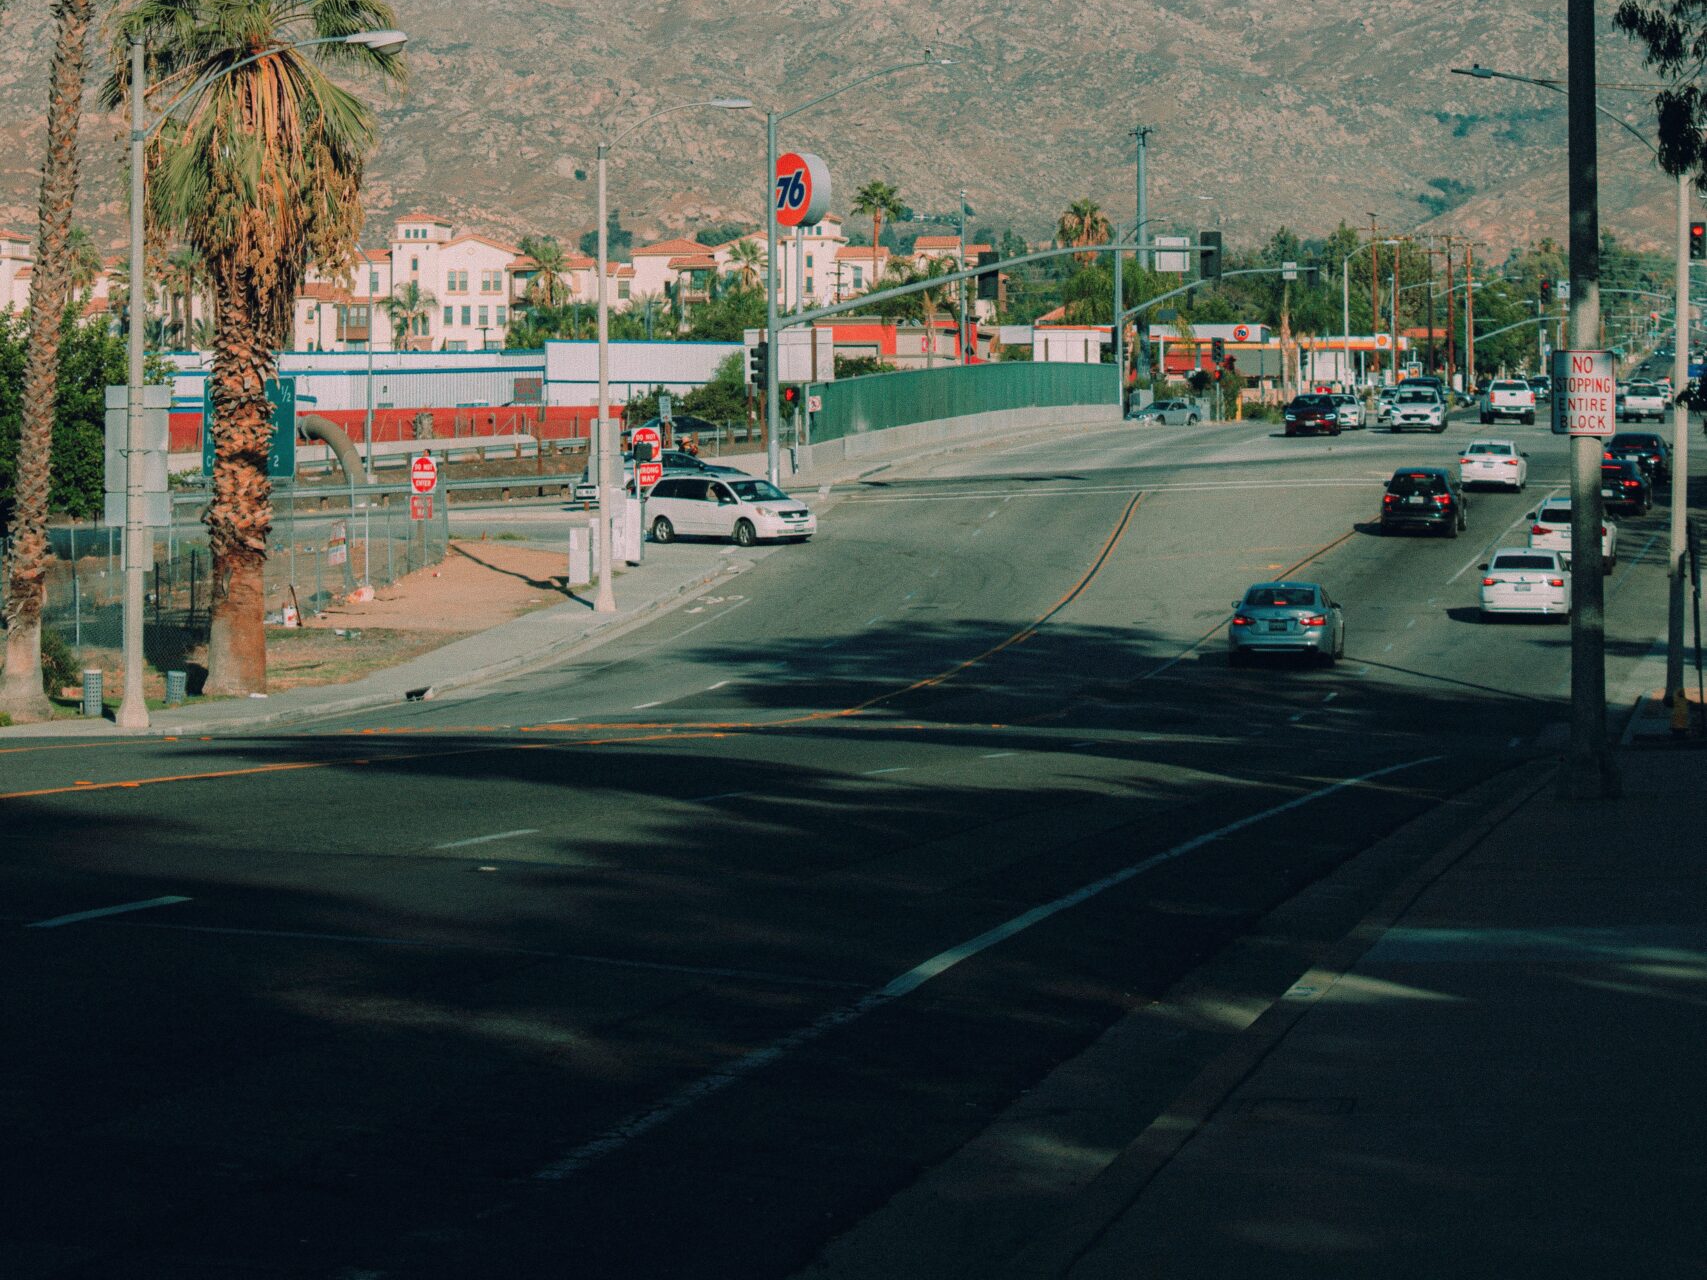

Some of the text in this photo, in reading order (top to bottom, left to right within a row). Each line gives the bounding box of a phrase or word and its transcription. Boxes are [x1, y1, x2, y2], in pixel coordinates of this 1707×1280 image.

[776, 169, 805, 209] 76
[1237, 329, 1247, 337] 76
[1572, 356, 1593, 374] NO
[1555, 377, 1611, 393] STOPPING
[1558, 397, 1607, 412] ENTIRE
[1560, 415, 1606, 429] BLOCK
